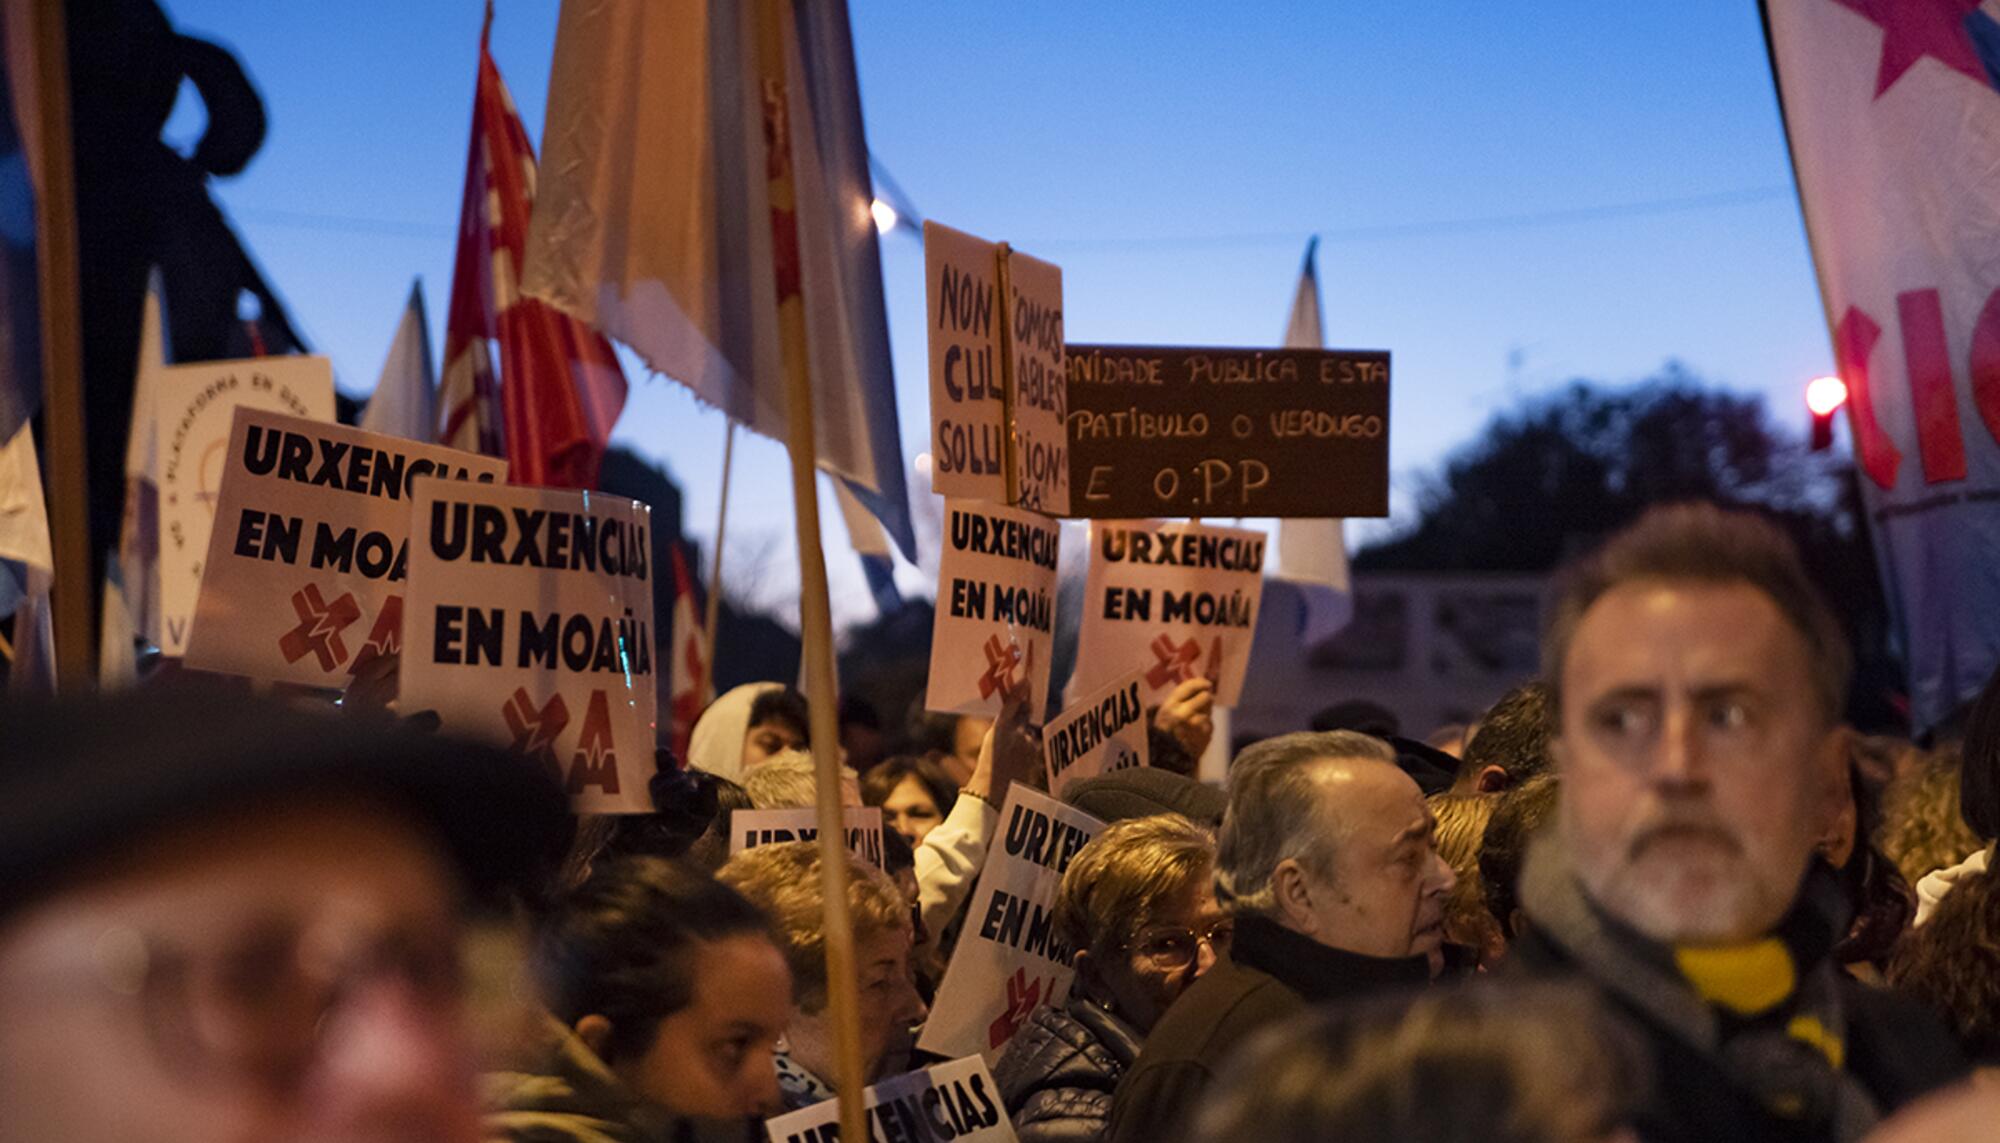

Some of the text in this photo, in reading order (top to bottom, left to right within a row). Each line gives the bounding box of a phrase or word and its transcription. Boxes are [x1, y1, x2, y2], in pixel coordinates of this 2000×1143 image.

[939, 263, 1062, 365] NON OMOS
[166, 373, 239, 479] PLATAFORMA
[252, 371, 273, 391] EN
[1232, 415, 1250, 438] O
[1270, 410, 1382, 438] VERDUGO
[1085, 465, 1113, 499] E
[234, 508, 303, 565] EN
[430, 500, 648, 581] URXENCIAS
[951, 510, 1057, 573] URXENCIAS
[1101, 528, 1264, 574] URXENCIAS
[950, 578, 1051, 634] EN MOAÑA
[1102, 587, 1250, 629] EN MOAÑA
[433, 604, 651, 675] EN MOAÑA
[1048, 681, 1141, 779] URXENCIAS
[979, 888, 1031, 948] EN
